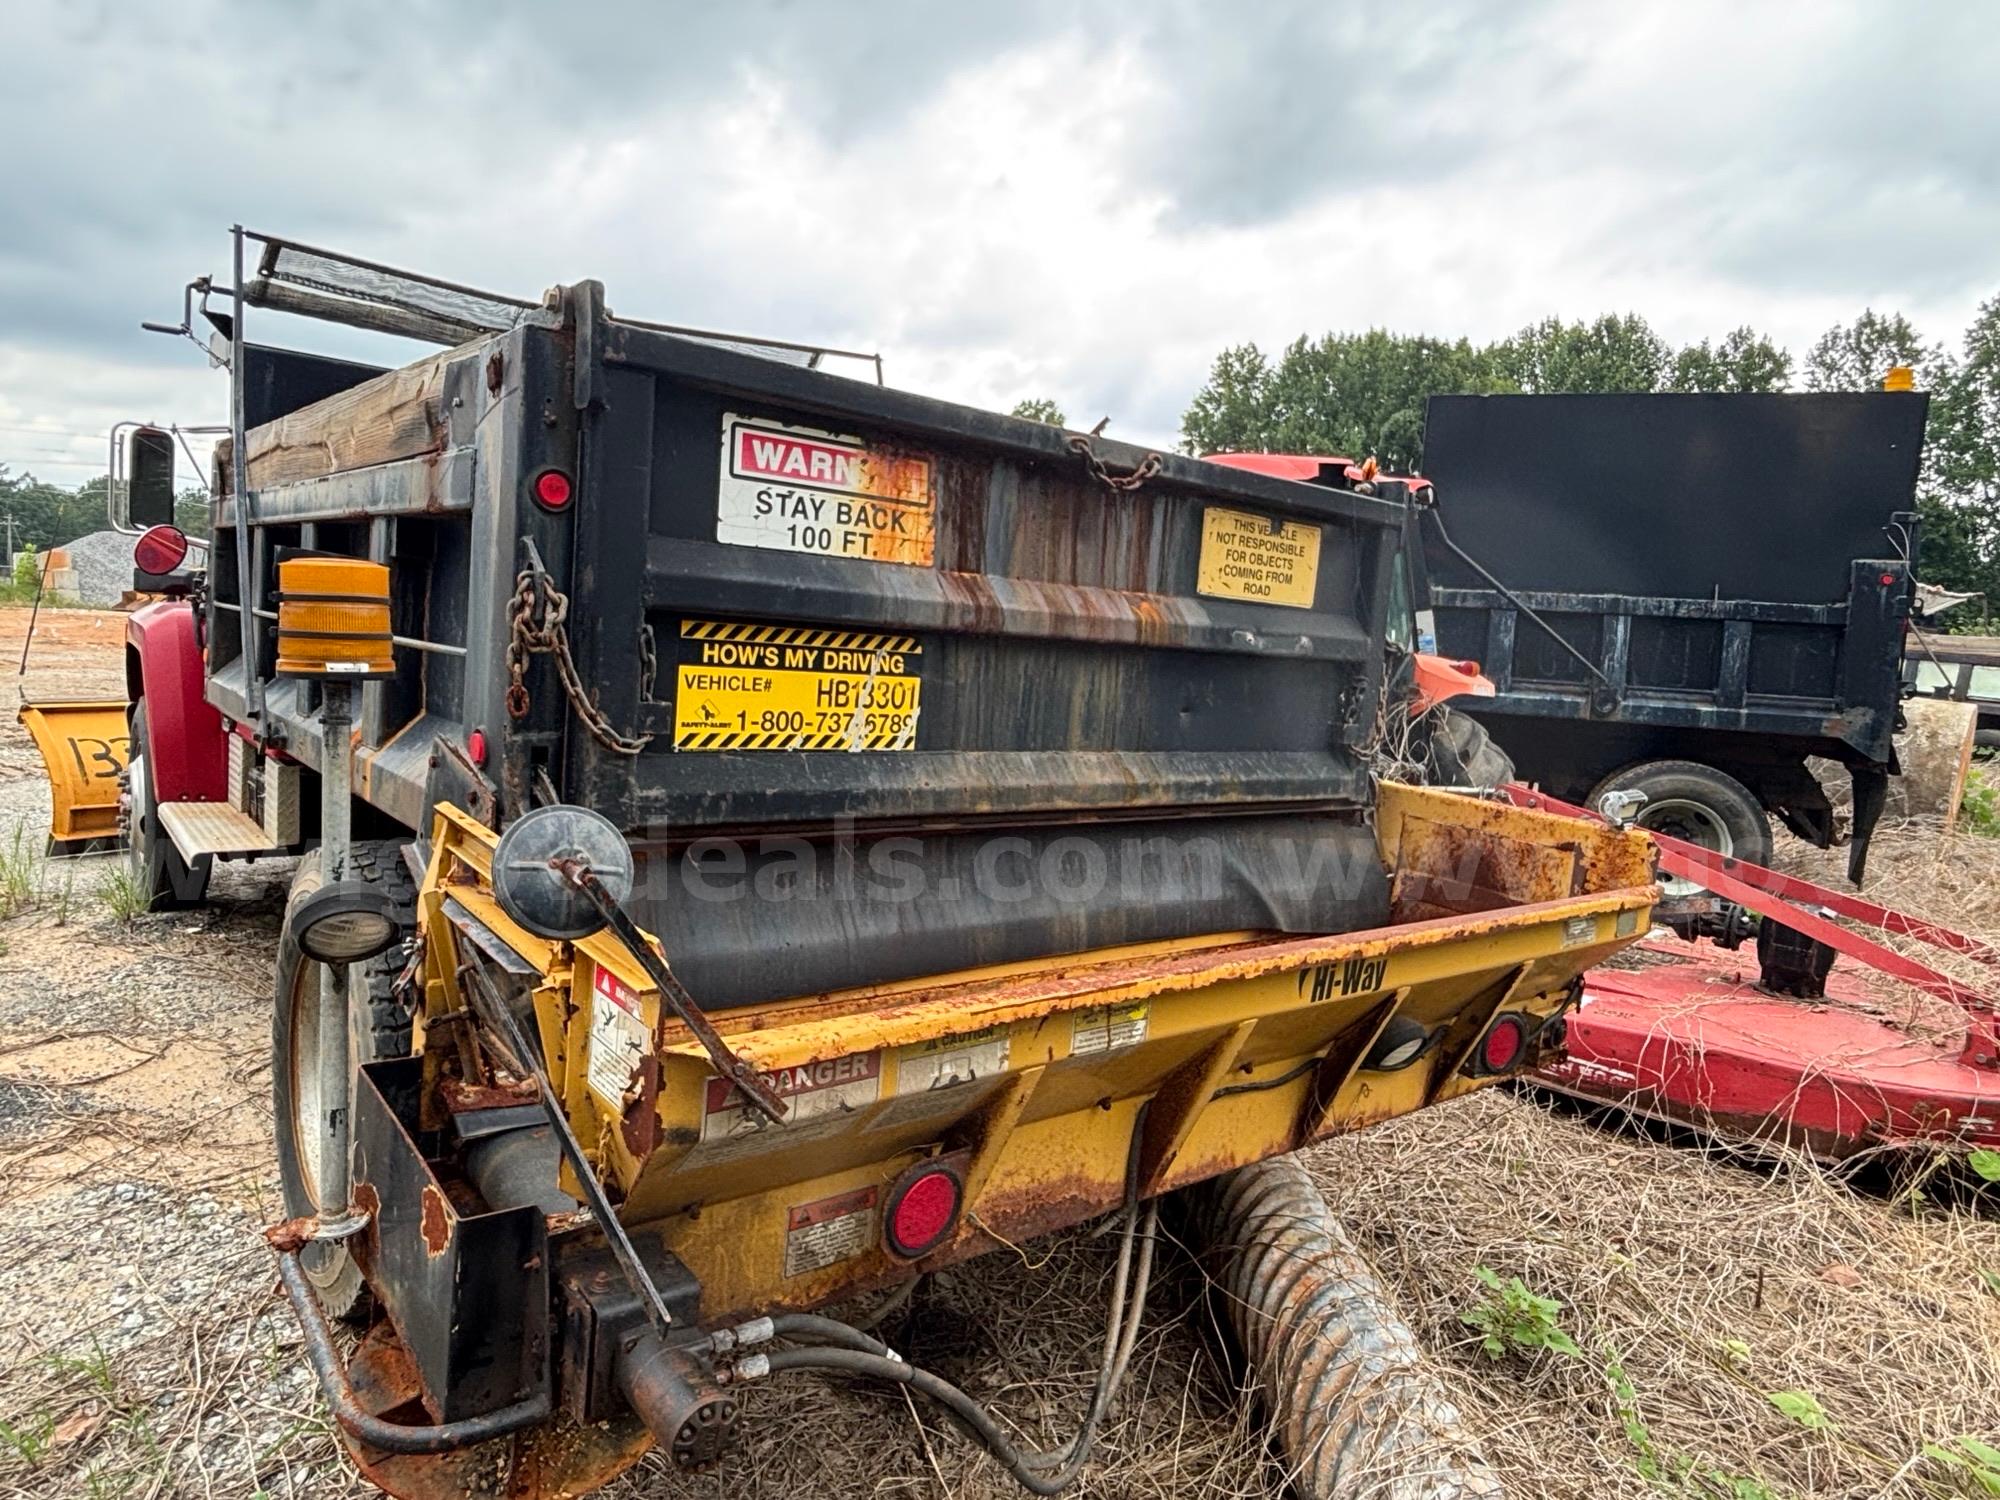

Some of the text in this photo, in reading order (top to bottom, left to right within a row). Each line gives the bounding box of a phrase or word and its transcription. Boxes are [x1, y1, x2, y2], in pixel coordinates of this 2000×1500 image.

[756, 489, 906, 533] STAY BACK
[787, 525, 831, 550] 100
[1234, 519, 1297, 541] THIS VECLE
[1216, 532, 1305, 557] NOT RESPONSIBLE
[1226, 549, 1293, 570] FOR OBJECTS
[1224, 565, 1293, 585] COMING FROM
[1243, 583, 1271, 596] ROAD
[703, 643, 904, 674] HOW'S MY DRIVING
[684, 674, 772, 692] VEHICLE#
[737, 710, 914, 735] 1-800-7376789
[1310, 958, 1388, 1003] Hi-Way
